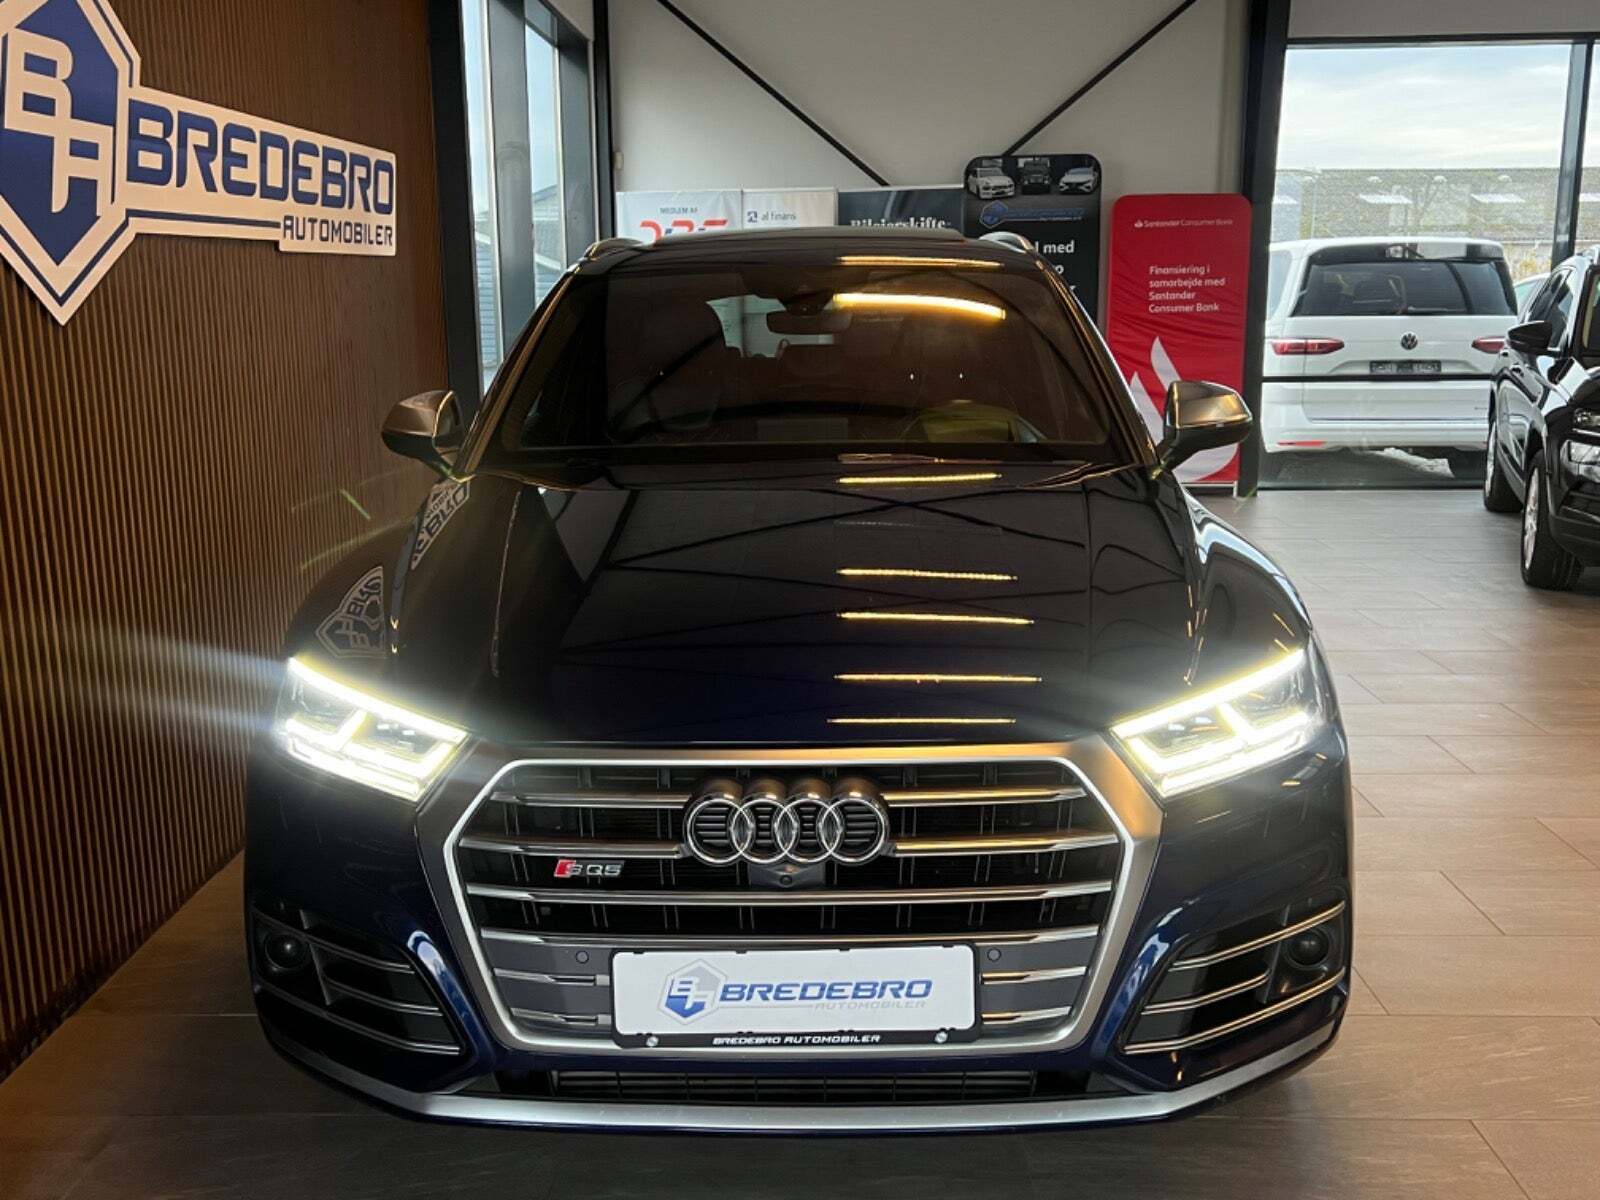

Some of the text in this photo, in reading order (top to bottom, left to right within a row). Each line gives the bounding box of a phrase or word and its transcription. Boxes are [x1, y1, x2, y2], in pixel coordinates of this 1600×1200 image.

[126, 97, 395, 216] BREDEBRO
[1143, 219, 1180, 228] Santander
[282, 215, 394, 247] AUTOMOBILER
[1043, 240, 1075, 254] med
[1149, 264, 1206, 277] Finansiering
[1149, 277, 1226, 289] samarbejde med
[1148, 291, 1196, 301] Santander
[1148, 302, 1219, 314] Consumer Bank
[719, 979, 933, 1002] BREDEBRO
[813, 1000, 927, 1011] AUTOMOBILER
[712, 1034, 881, 1046] BREDEBRO AUTOMOBILER
